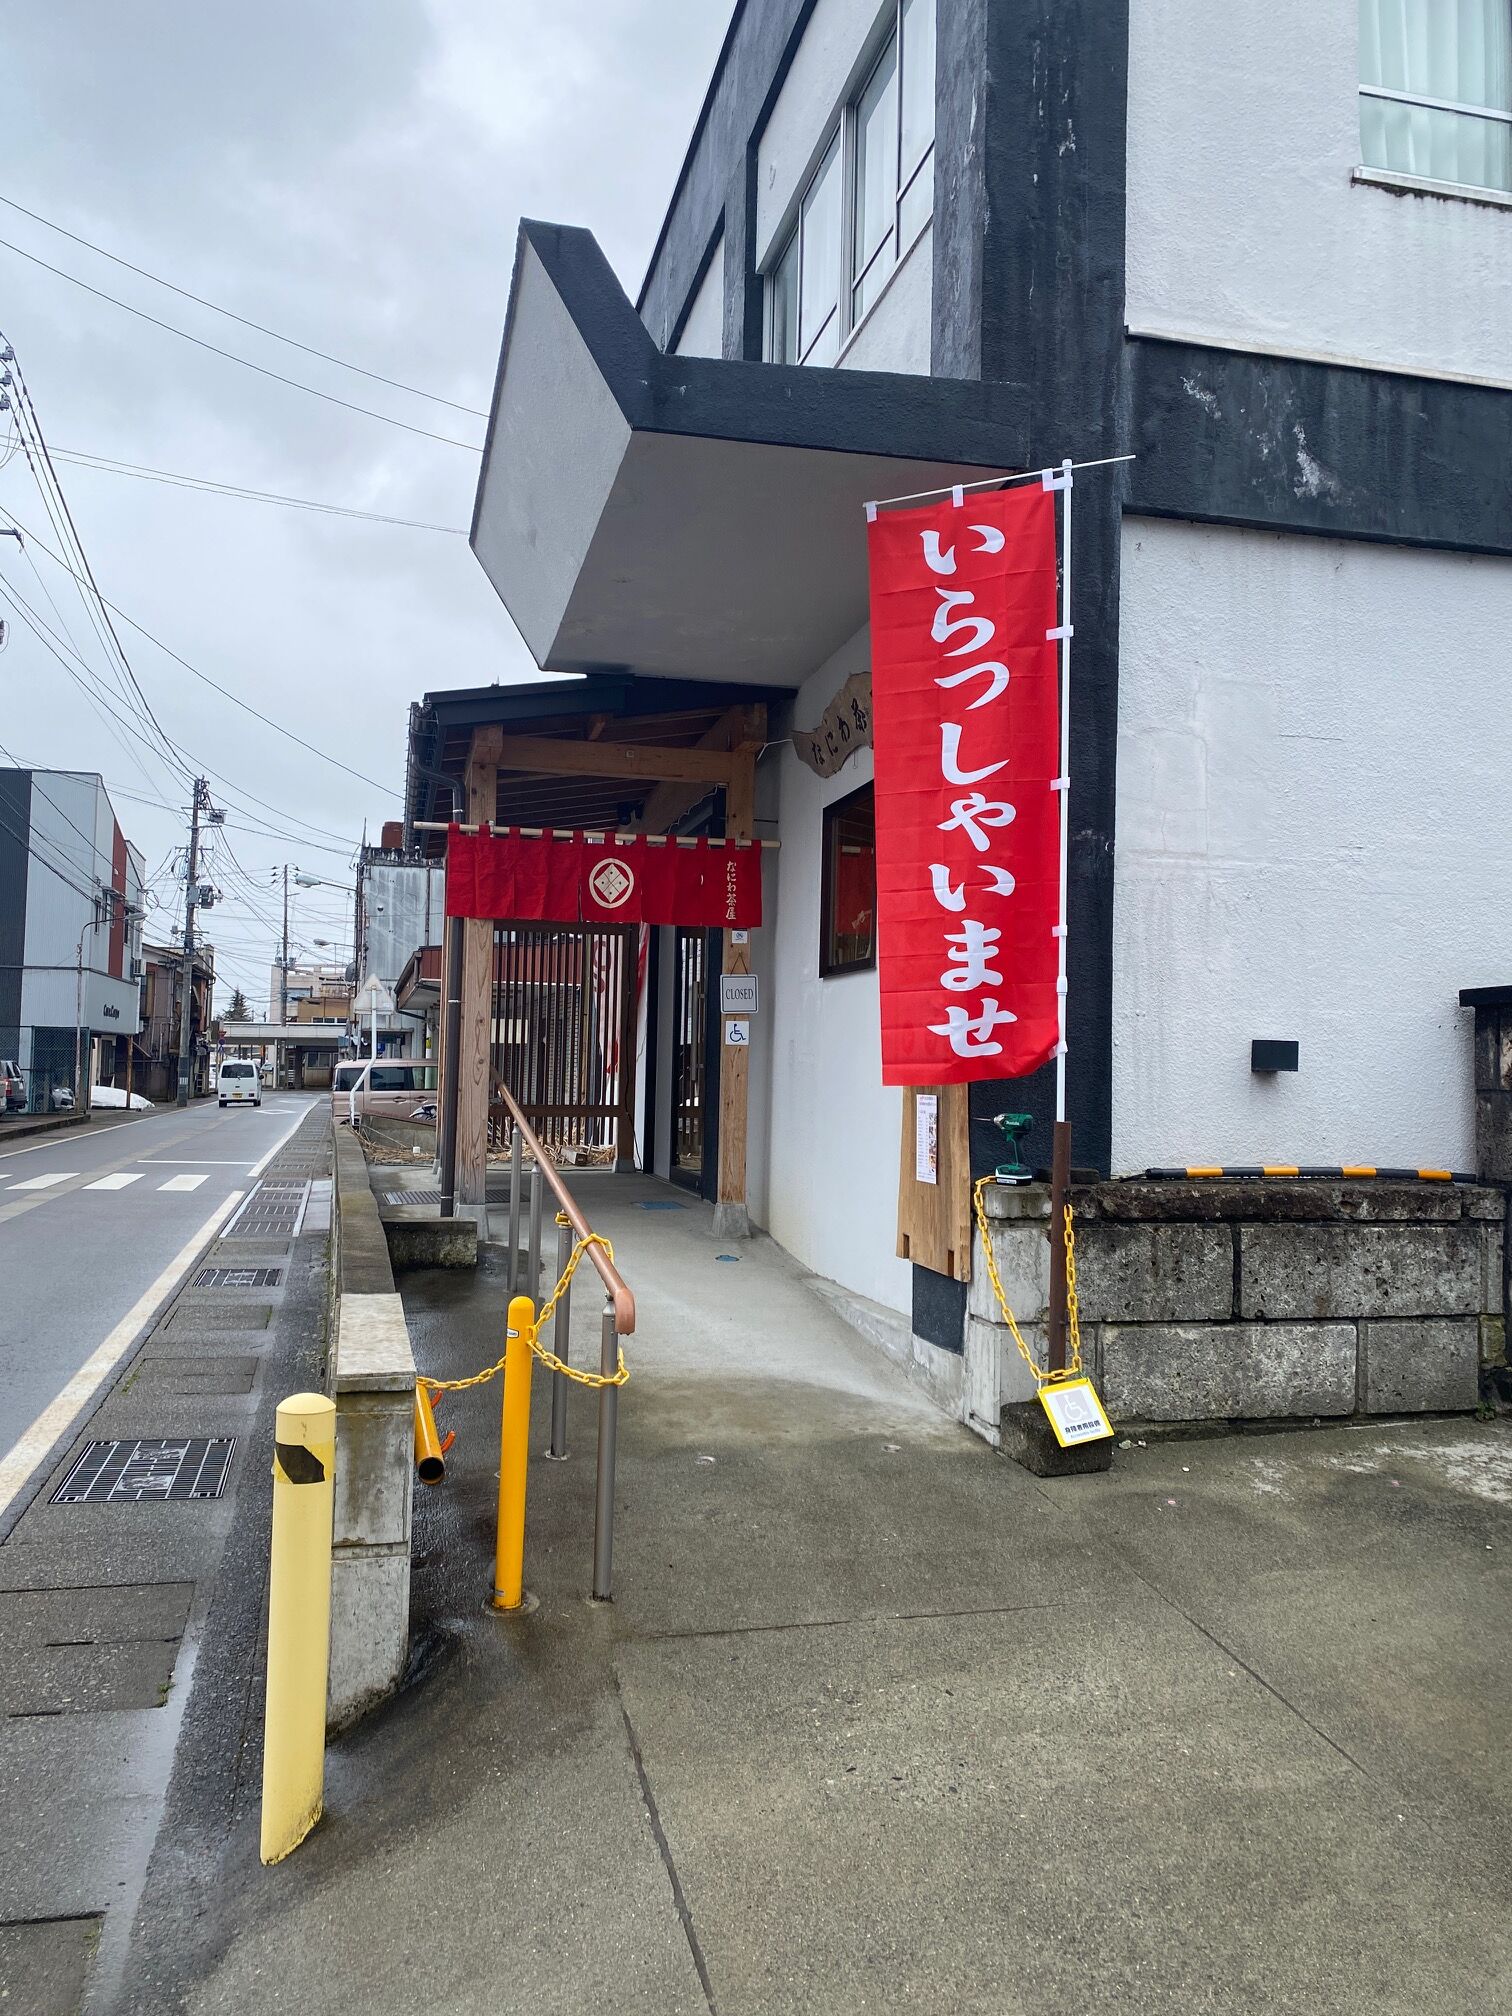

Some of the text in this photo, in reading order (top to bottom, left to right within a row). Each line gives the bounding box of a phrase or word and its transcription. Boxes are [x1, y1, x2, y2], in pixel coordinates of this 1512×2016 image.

[811, 689, 873, 765] なにわ茶
[725, 860, 737, 920] なにわ茶屋
[725, 988, 754, 1000] CLOSED
